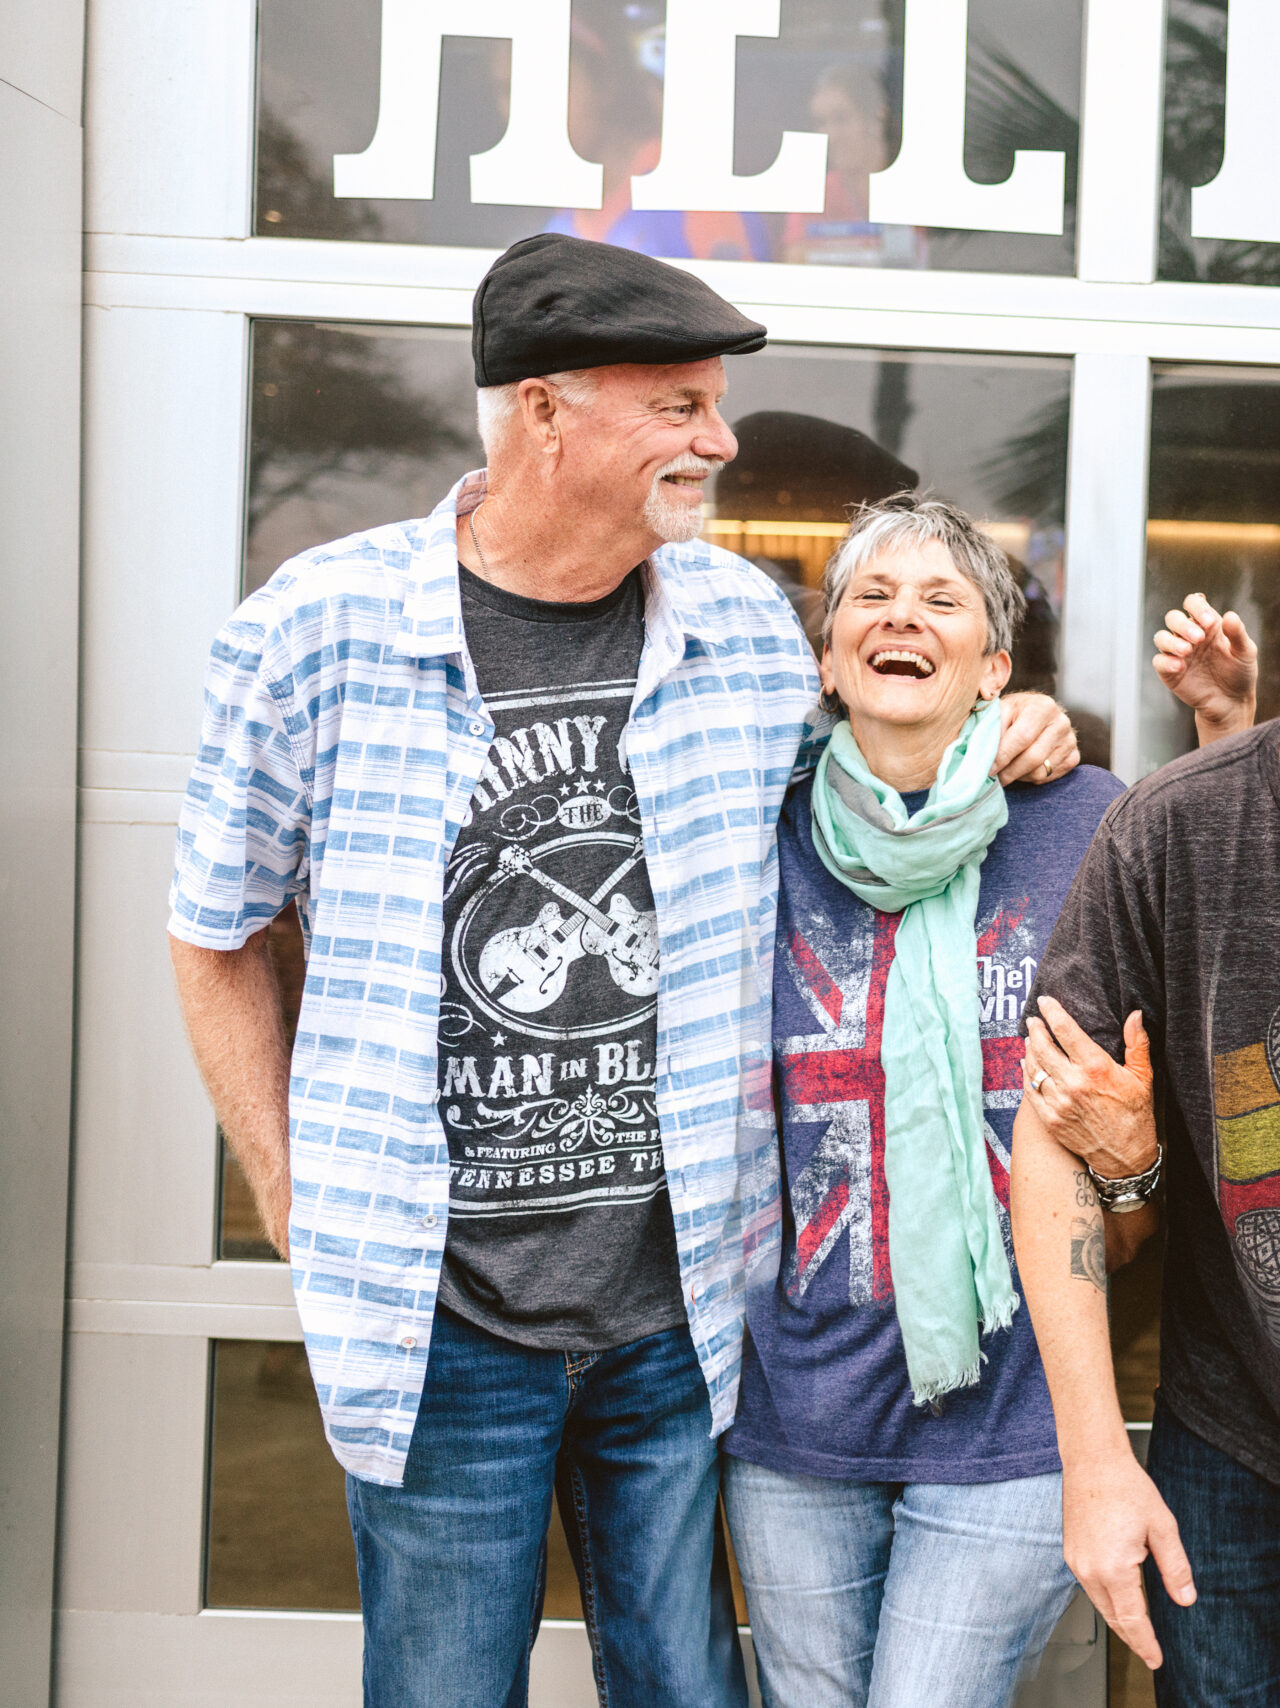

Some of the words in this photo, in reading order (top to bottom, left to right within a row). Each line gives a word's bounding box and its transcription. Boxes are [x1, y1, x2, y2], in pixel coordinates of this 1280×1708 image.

[462, 714, 608, 828] HNNY
[563, 803, 603, 824] THE
[442, 1053, 556, 1099] MAN
[559, 1058, 588, 1081] IN
[593, 1040, 657, 1086] BL
[464, 1146, 475, 1157] &
[476, 1143, 556, 1160] FEATURING
[615, 1130, 647, 1144] THE
[650, 1128, 661, 1141] F
[448, 1155, 616, 1188] TENNESSEE
